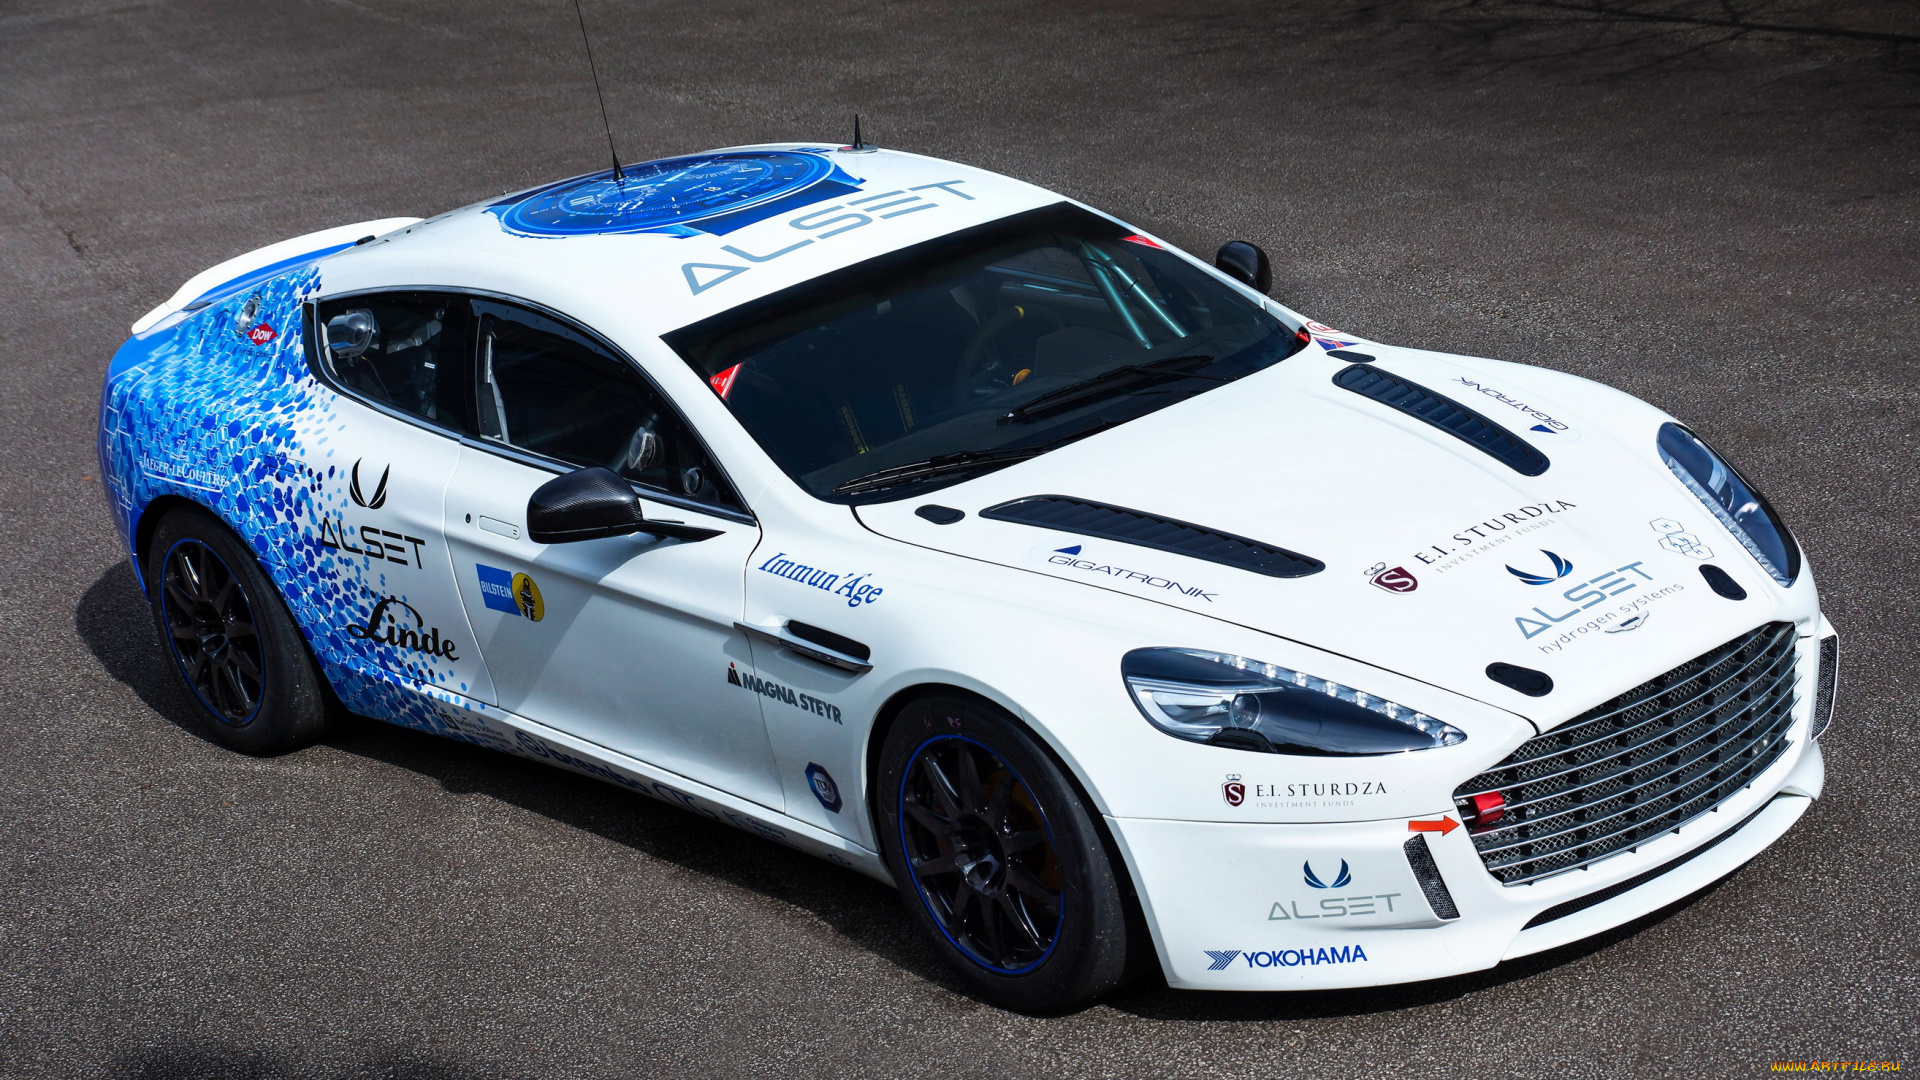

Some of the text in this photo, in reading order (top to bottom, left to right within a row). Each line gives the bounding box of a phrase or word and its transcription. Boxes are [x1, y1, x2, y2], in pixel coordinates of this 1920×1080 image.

[681, 180, 976, 295] ALSET
[1452, 377, 1569, 430] GIGATRONIK
[320, 517, 425, 570] ALSET
[1414, 500, 1578, 565] E.I. STURDZA
[1436, 518, 1556, 573] INVESTMENT FUNDS
[480, 580, 513, 599] BILSTEIN
[1048, 555, 1219, 603] GIGATRONIK
[1515, 561, 1653, 640] ALSET
[346, 599, 460, 661] Linde
[1538, 582, 1685, 654] hydrogen systems
[742, 672, 843, 726] MAGNA STEYR
[1256, 782, 1387, 797] E.I. STURDZA
[1267, 893, 1402, 921] ALSET
[1242, 945, 1368, 969] YOKOHAMA
